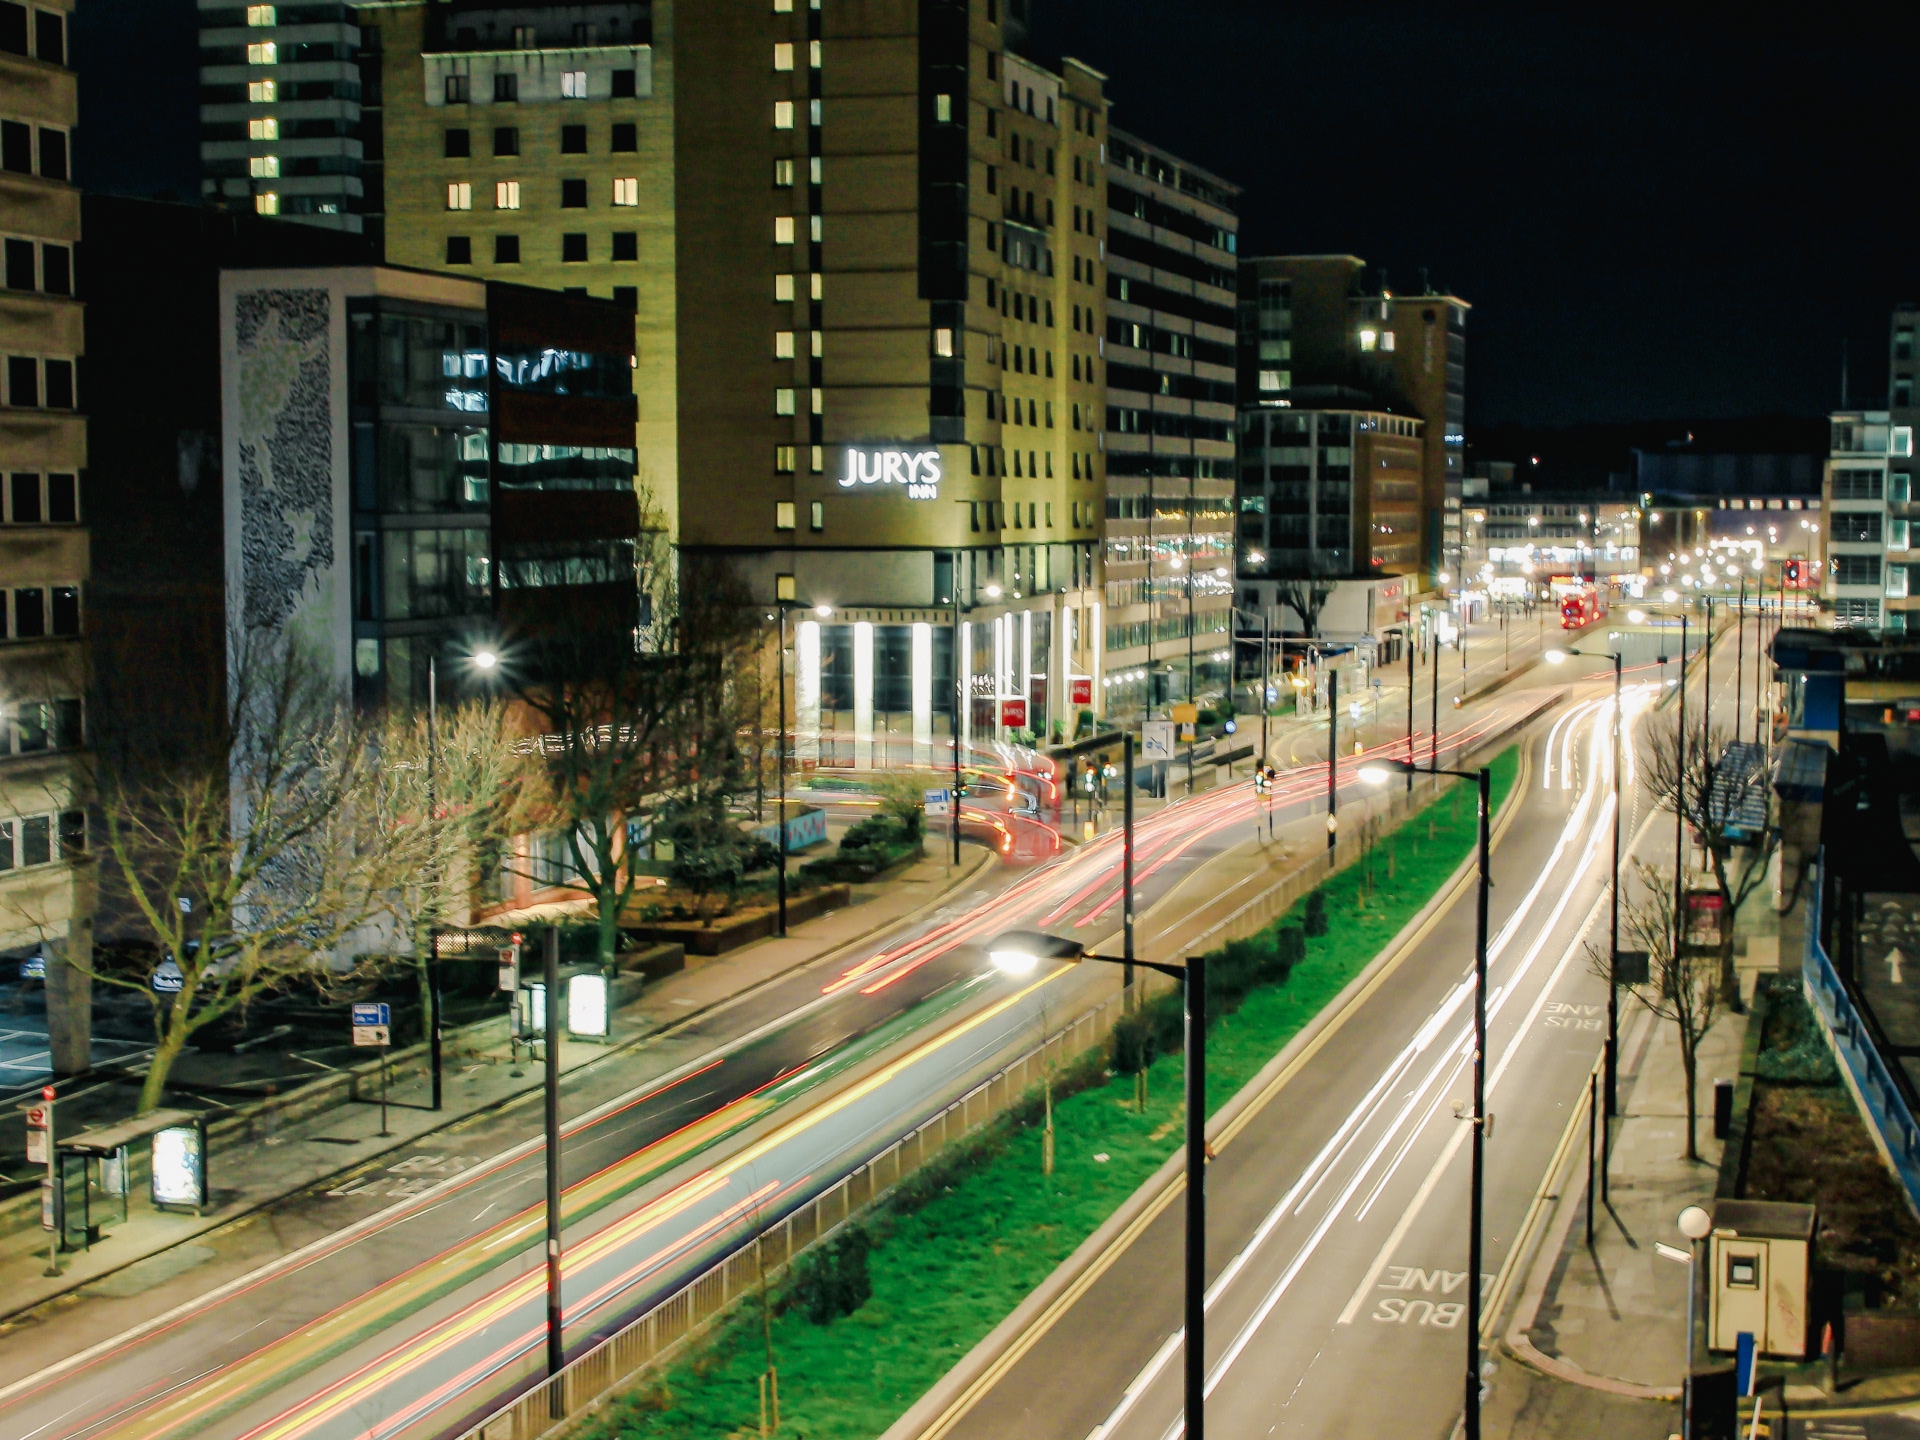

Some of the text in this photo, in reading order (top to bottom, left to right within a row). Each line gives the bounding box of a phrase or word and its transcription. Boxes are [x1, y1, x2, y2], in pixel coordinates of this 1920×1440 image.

[838, 448, 941, 487] JURYS
[908, 484, 937, 499] INN
[1543, 1001, 1603, 1016] ANE
[1544, 1016, 1603, 1031] BUS
[1372, 1298, 1466, 1329] BUS
